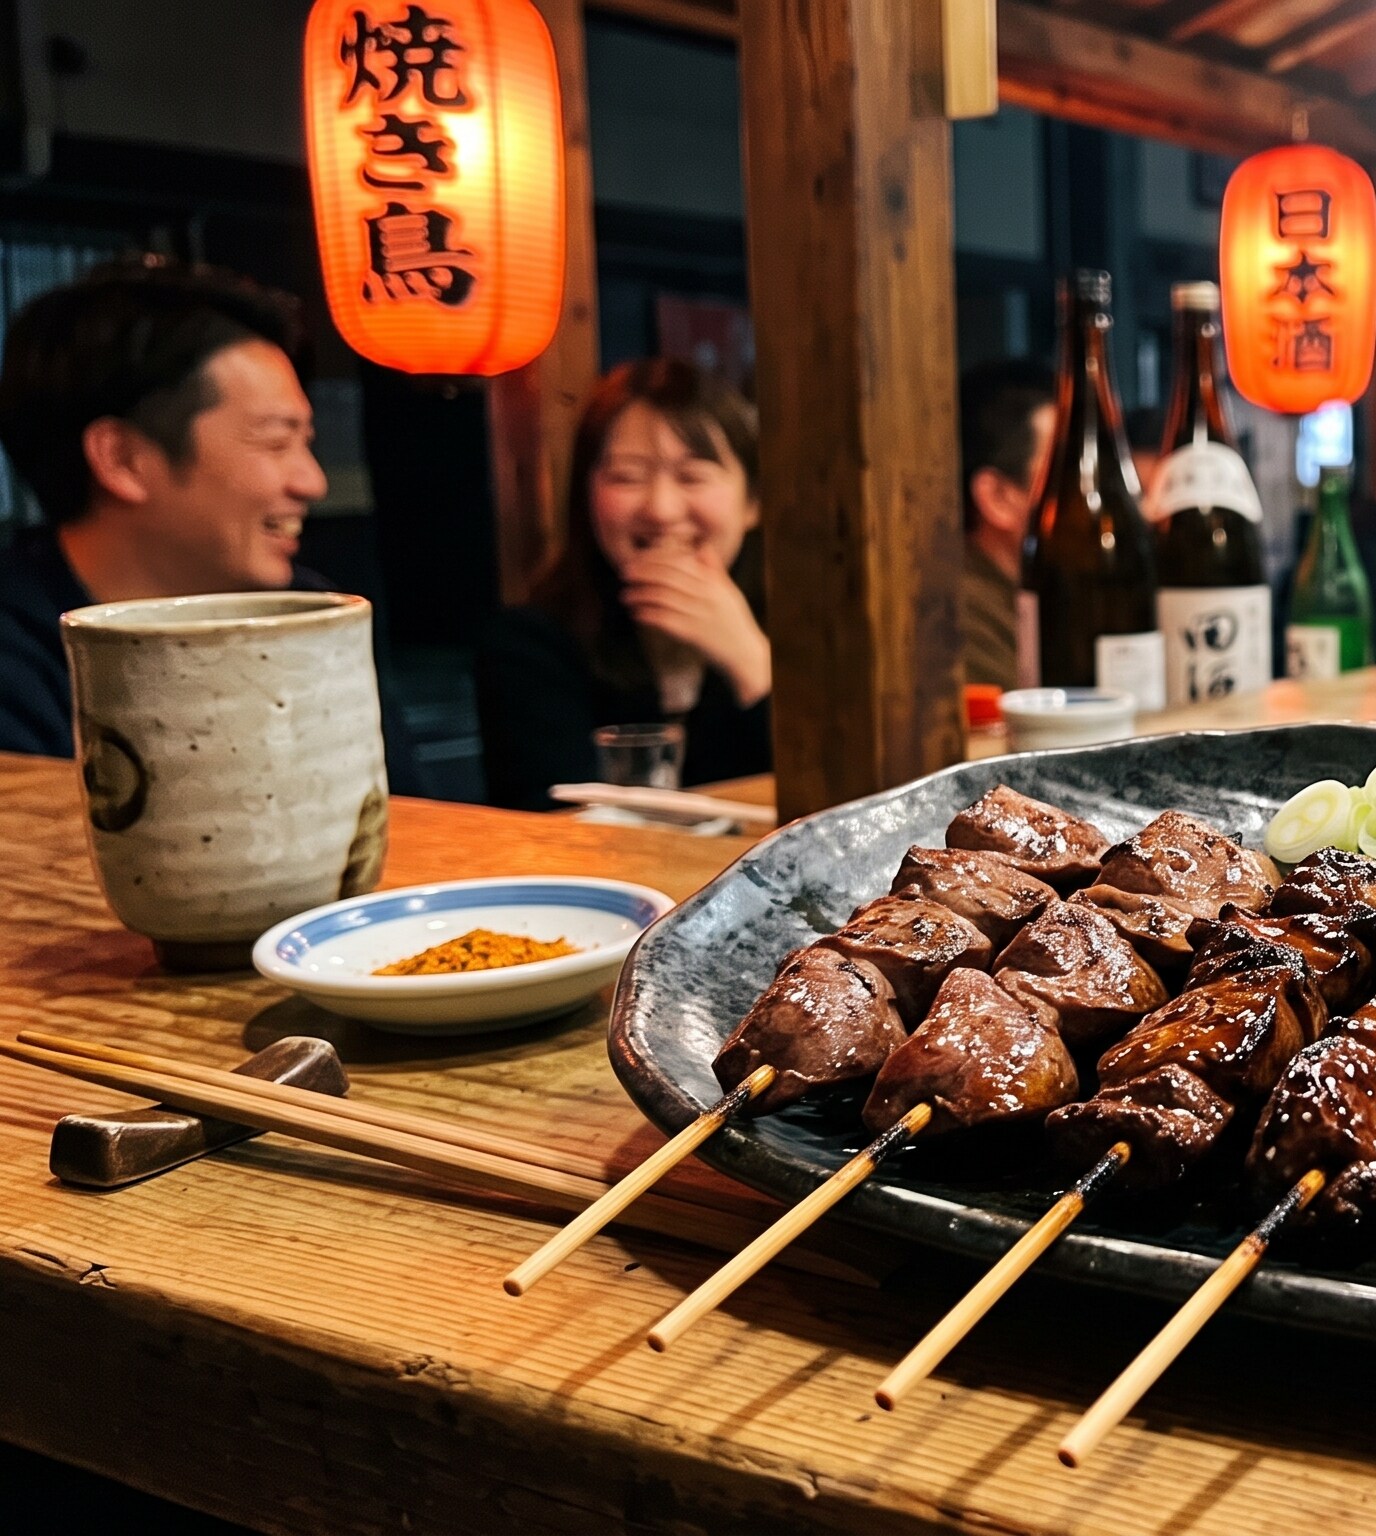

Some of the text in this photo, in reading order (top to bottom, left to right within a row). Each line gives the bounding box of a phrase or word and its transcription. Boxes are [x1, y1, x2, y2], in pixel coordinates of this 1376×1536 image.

[340, 4, 476, 307] 焼き鳥
[1272, 189, 1336, 371] 日本酒
